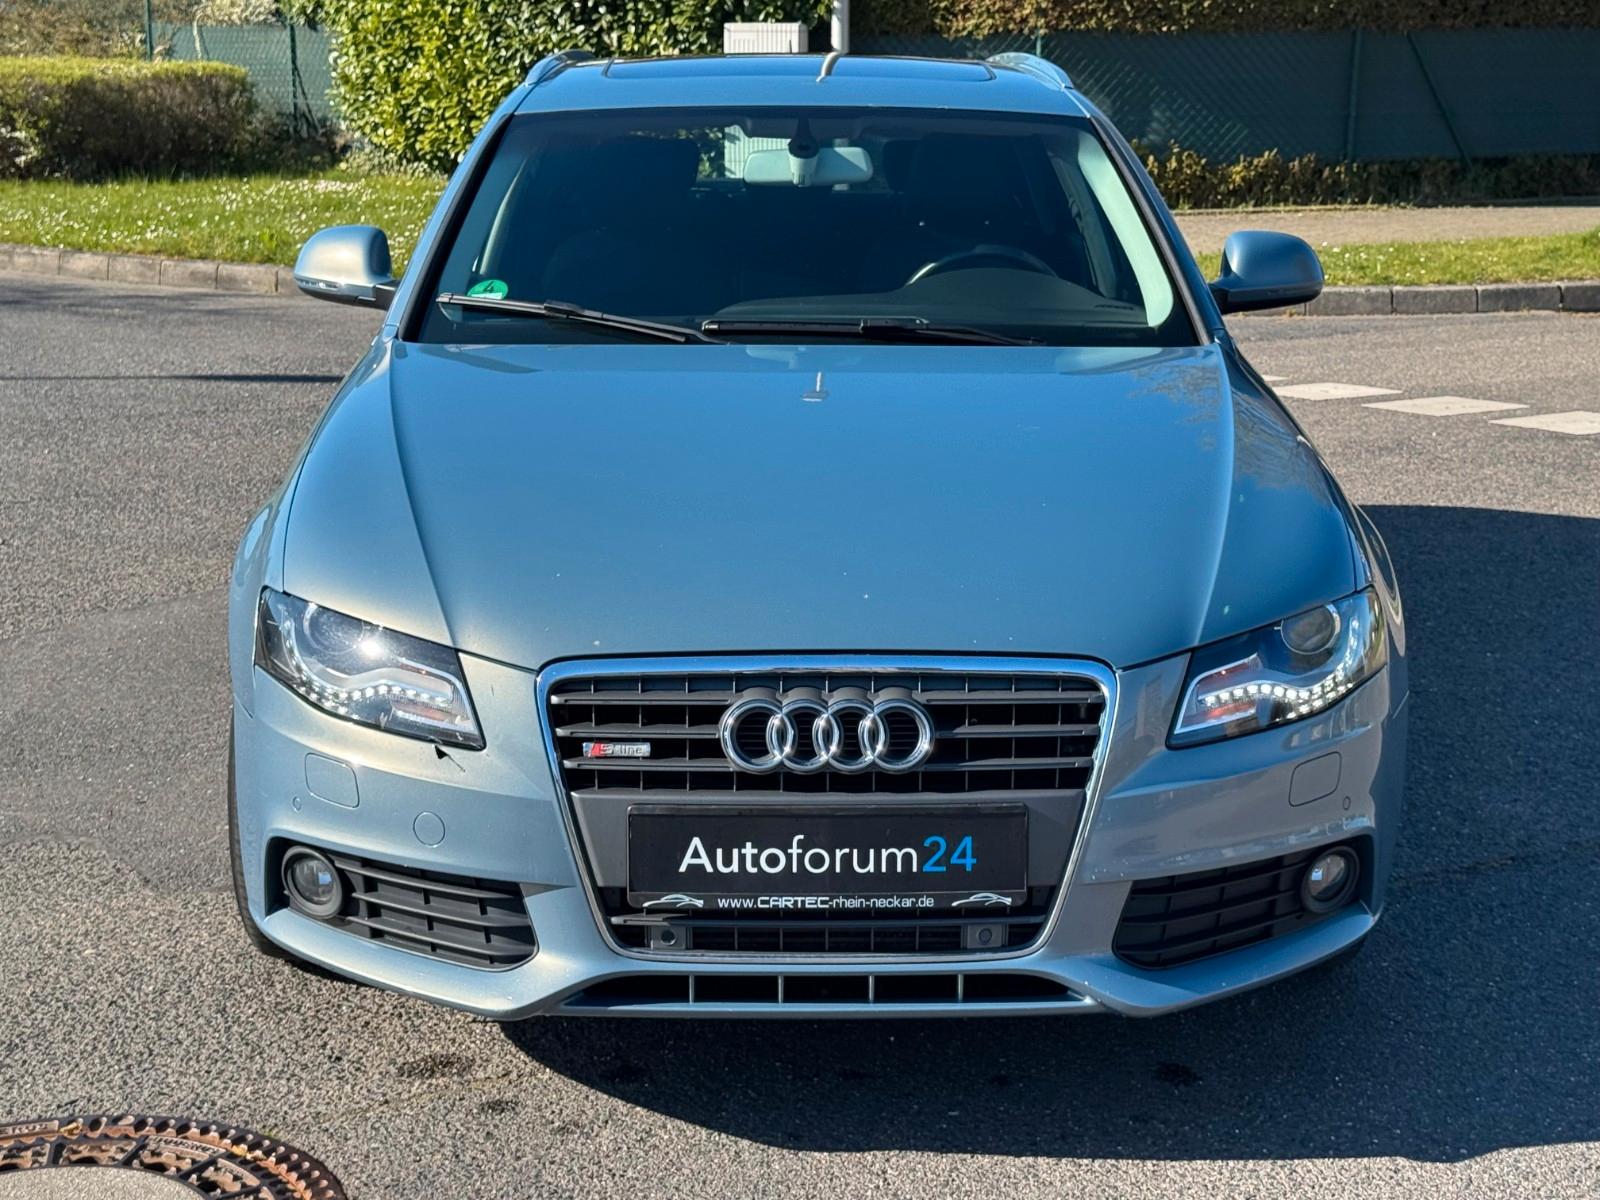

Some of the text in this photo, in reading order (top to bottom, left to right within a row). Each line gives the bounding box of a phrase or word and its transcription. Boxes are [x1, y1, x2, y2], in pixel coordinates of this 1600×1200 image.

[482, 281, 495, 293] 4
[678, 835, 977, 874] Autoforum24
[717, 895, 935, 910] www.CARTEC-rhein-neckar.de
